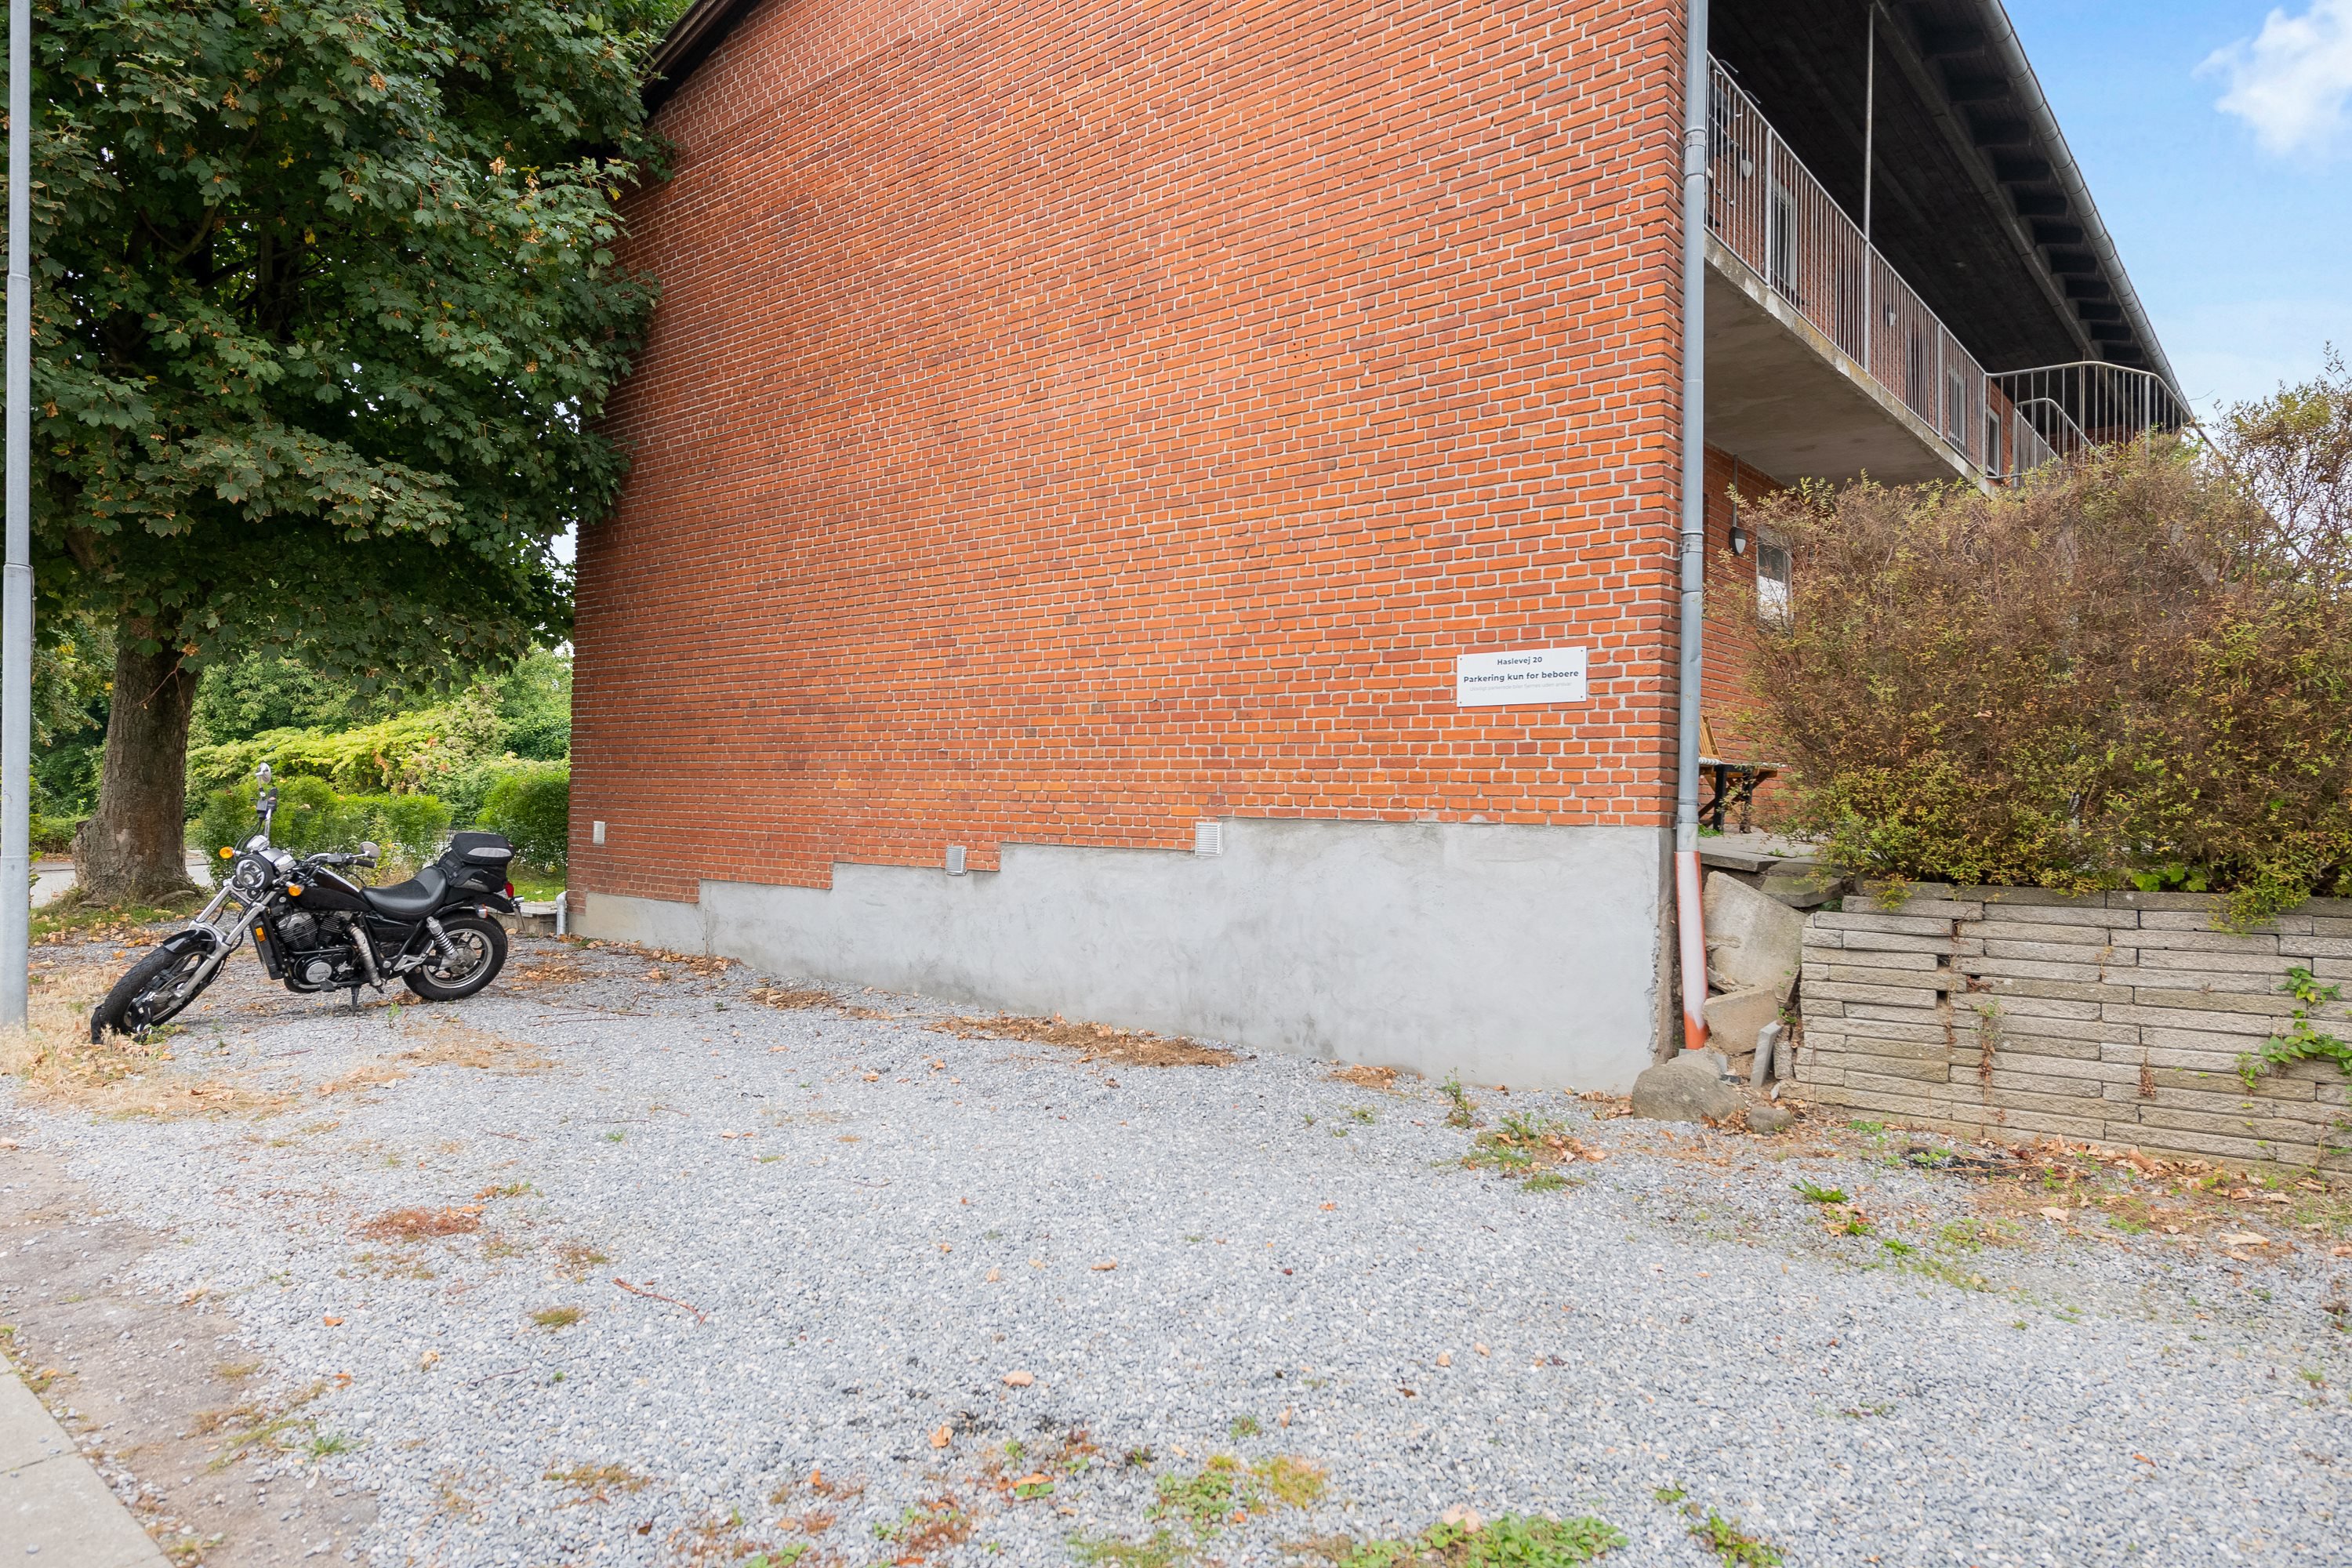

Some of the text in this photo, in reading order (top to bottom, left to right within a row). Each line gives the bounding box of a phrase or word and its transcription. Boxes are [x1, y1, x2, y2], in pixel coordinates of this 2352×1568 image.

[1497, 656, 1530, 666] Haslevej
[1464, 674, 1504, 683] Parkering
[1541, 670, 1579, 679] beboere
